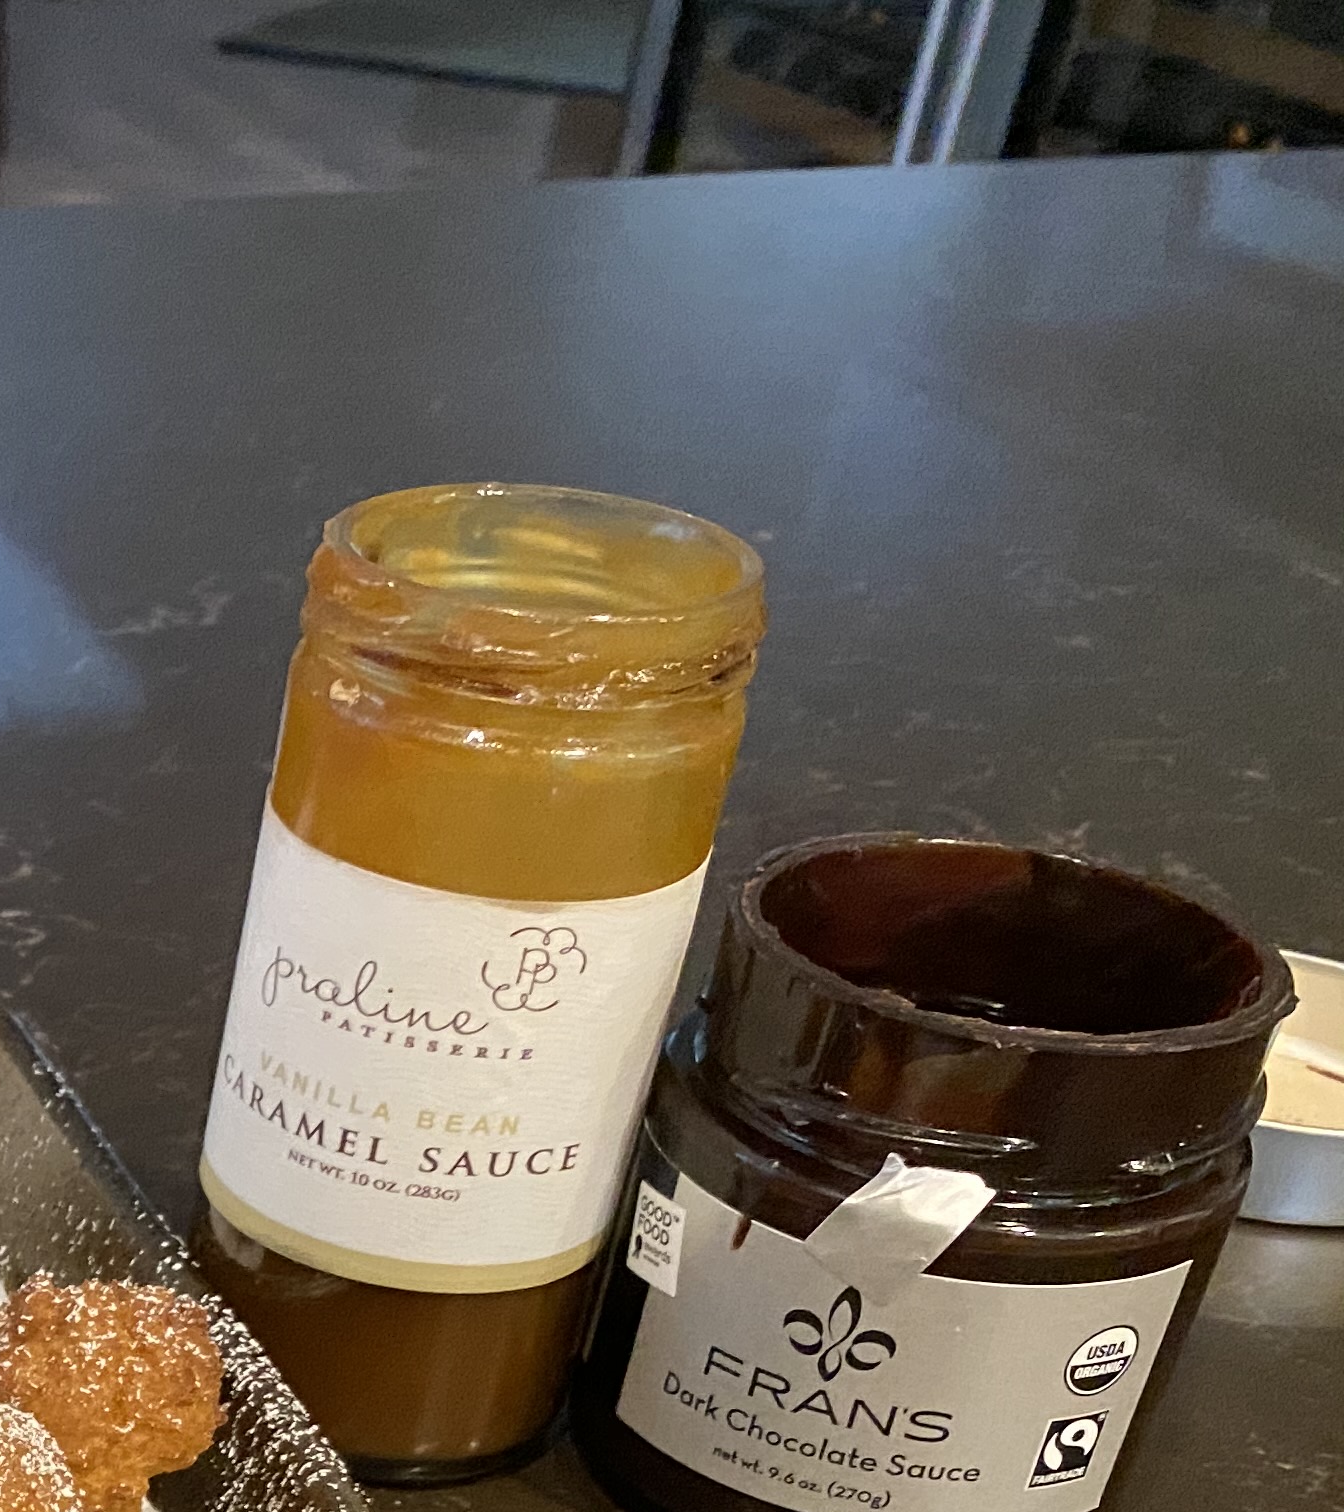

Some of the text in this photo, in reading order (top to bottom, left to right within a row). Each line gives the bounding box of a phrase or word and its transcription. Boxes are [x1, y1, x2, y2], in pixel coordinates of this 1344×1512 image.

[262, 946, 489, 1035] praline
[321, 1010, 534, 1060] PATISSERIE
[223, 1053, 581, 1178] CARAMEL SAUCE
[260, 1051, 520, 1136] VANILLA BEAN
[287, 1149, 314, 1170] NET
[318, 1162, 345, 1181] WT.
[351, 1171, 370, 1187] 10
[404, 1182, 462, 1203] (283G)
[637, 1213, 670, 1246] FOOD
[1073, 1359, 1125, 1381] ORGANIC
[1086, 1341, 1126, 1361] USDA
[703, 1345, 954, 1443] FRAN'S
[662, 1370, 981, 1483] Dark Chocolate Sauce
[712, 1446, 738, 1465] net
[741, 1455, 764, 1475] wt.
[768, 1466, 796, 1485] 9.6
[826, 1480, 892, 1511] (270g)
[1030, 1465, 1087, 1487] FAIRTRADE
